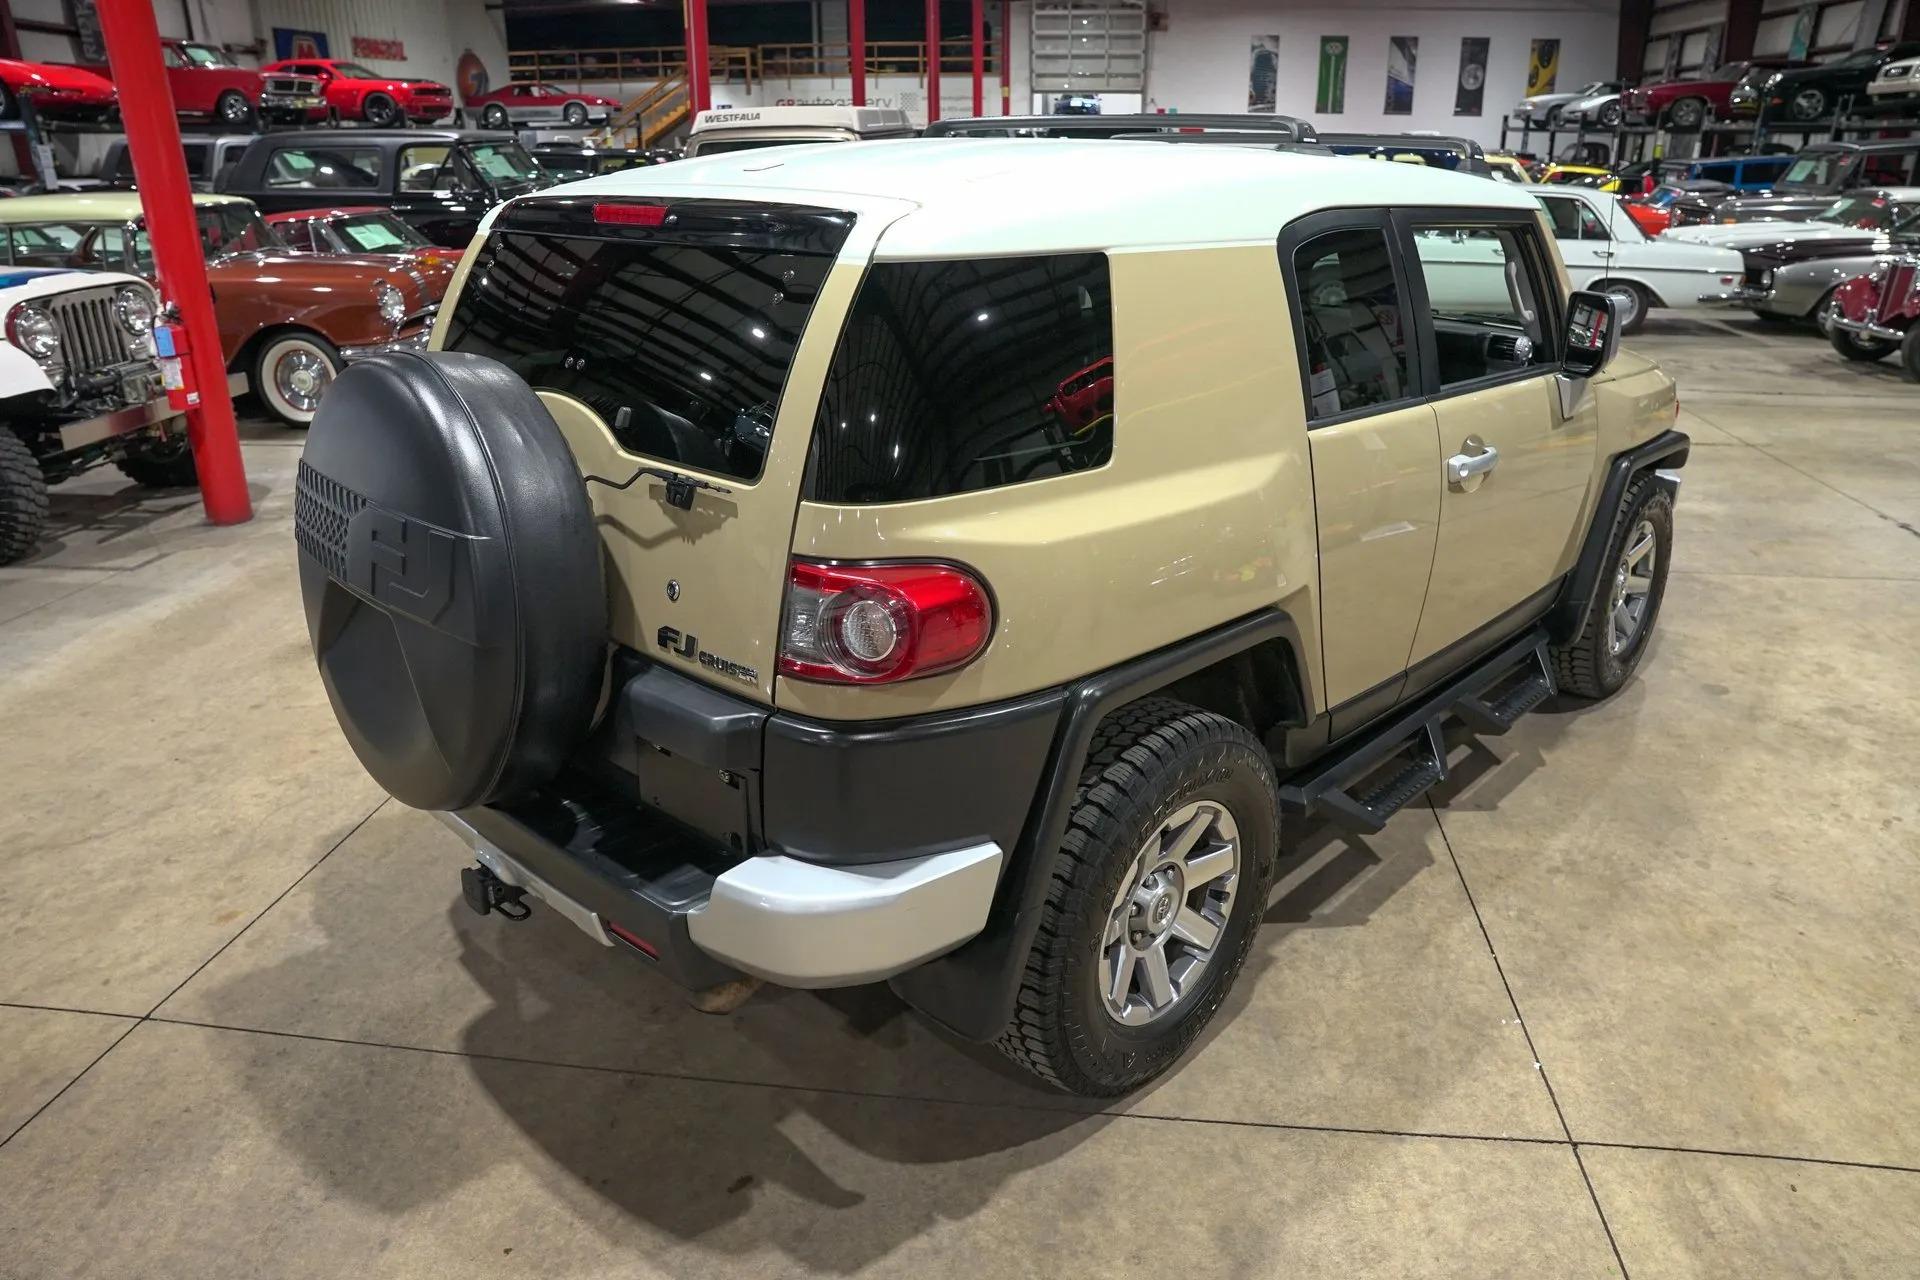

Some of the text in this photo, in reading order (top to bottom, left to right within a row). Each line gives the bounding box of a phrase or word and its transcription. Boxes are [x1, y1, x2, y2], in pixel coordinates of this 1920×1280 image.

[704, 112, 761, 123] WESTFALIA
[657, 625, 759, 685] FJ CRUISER
